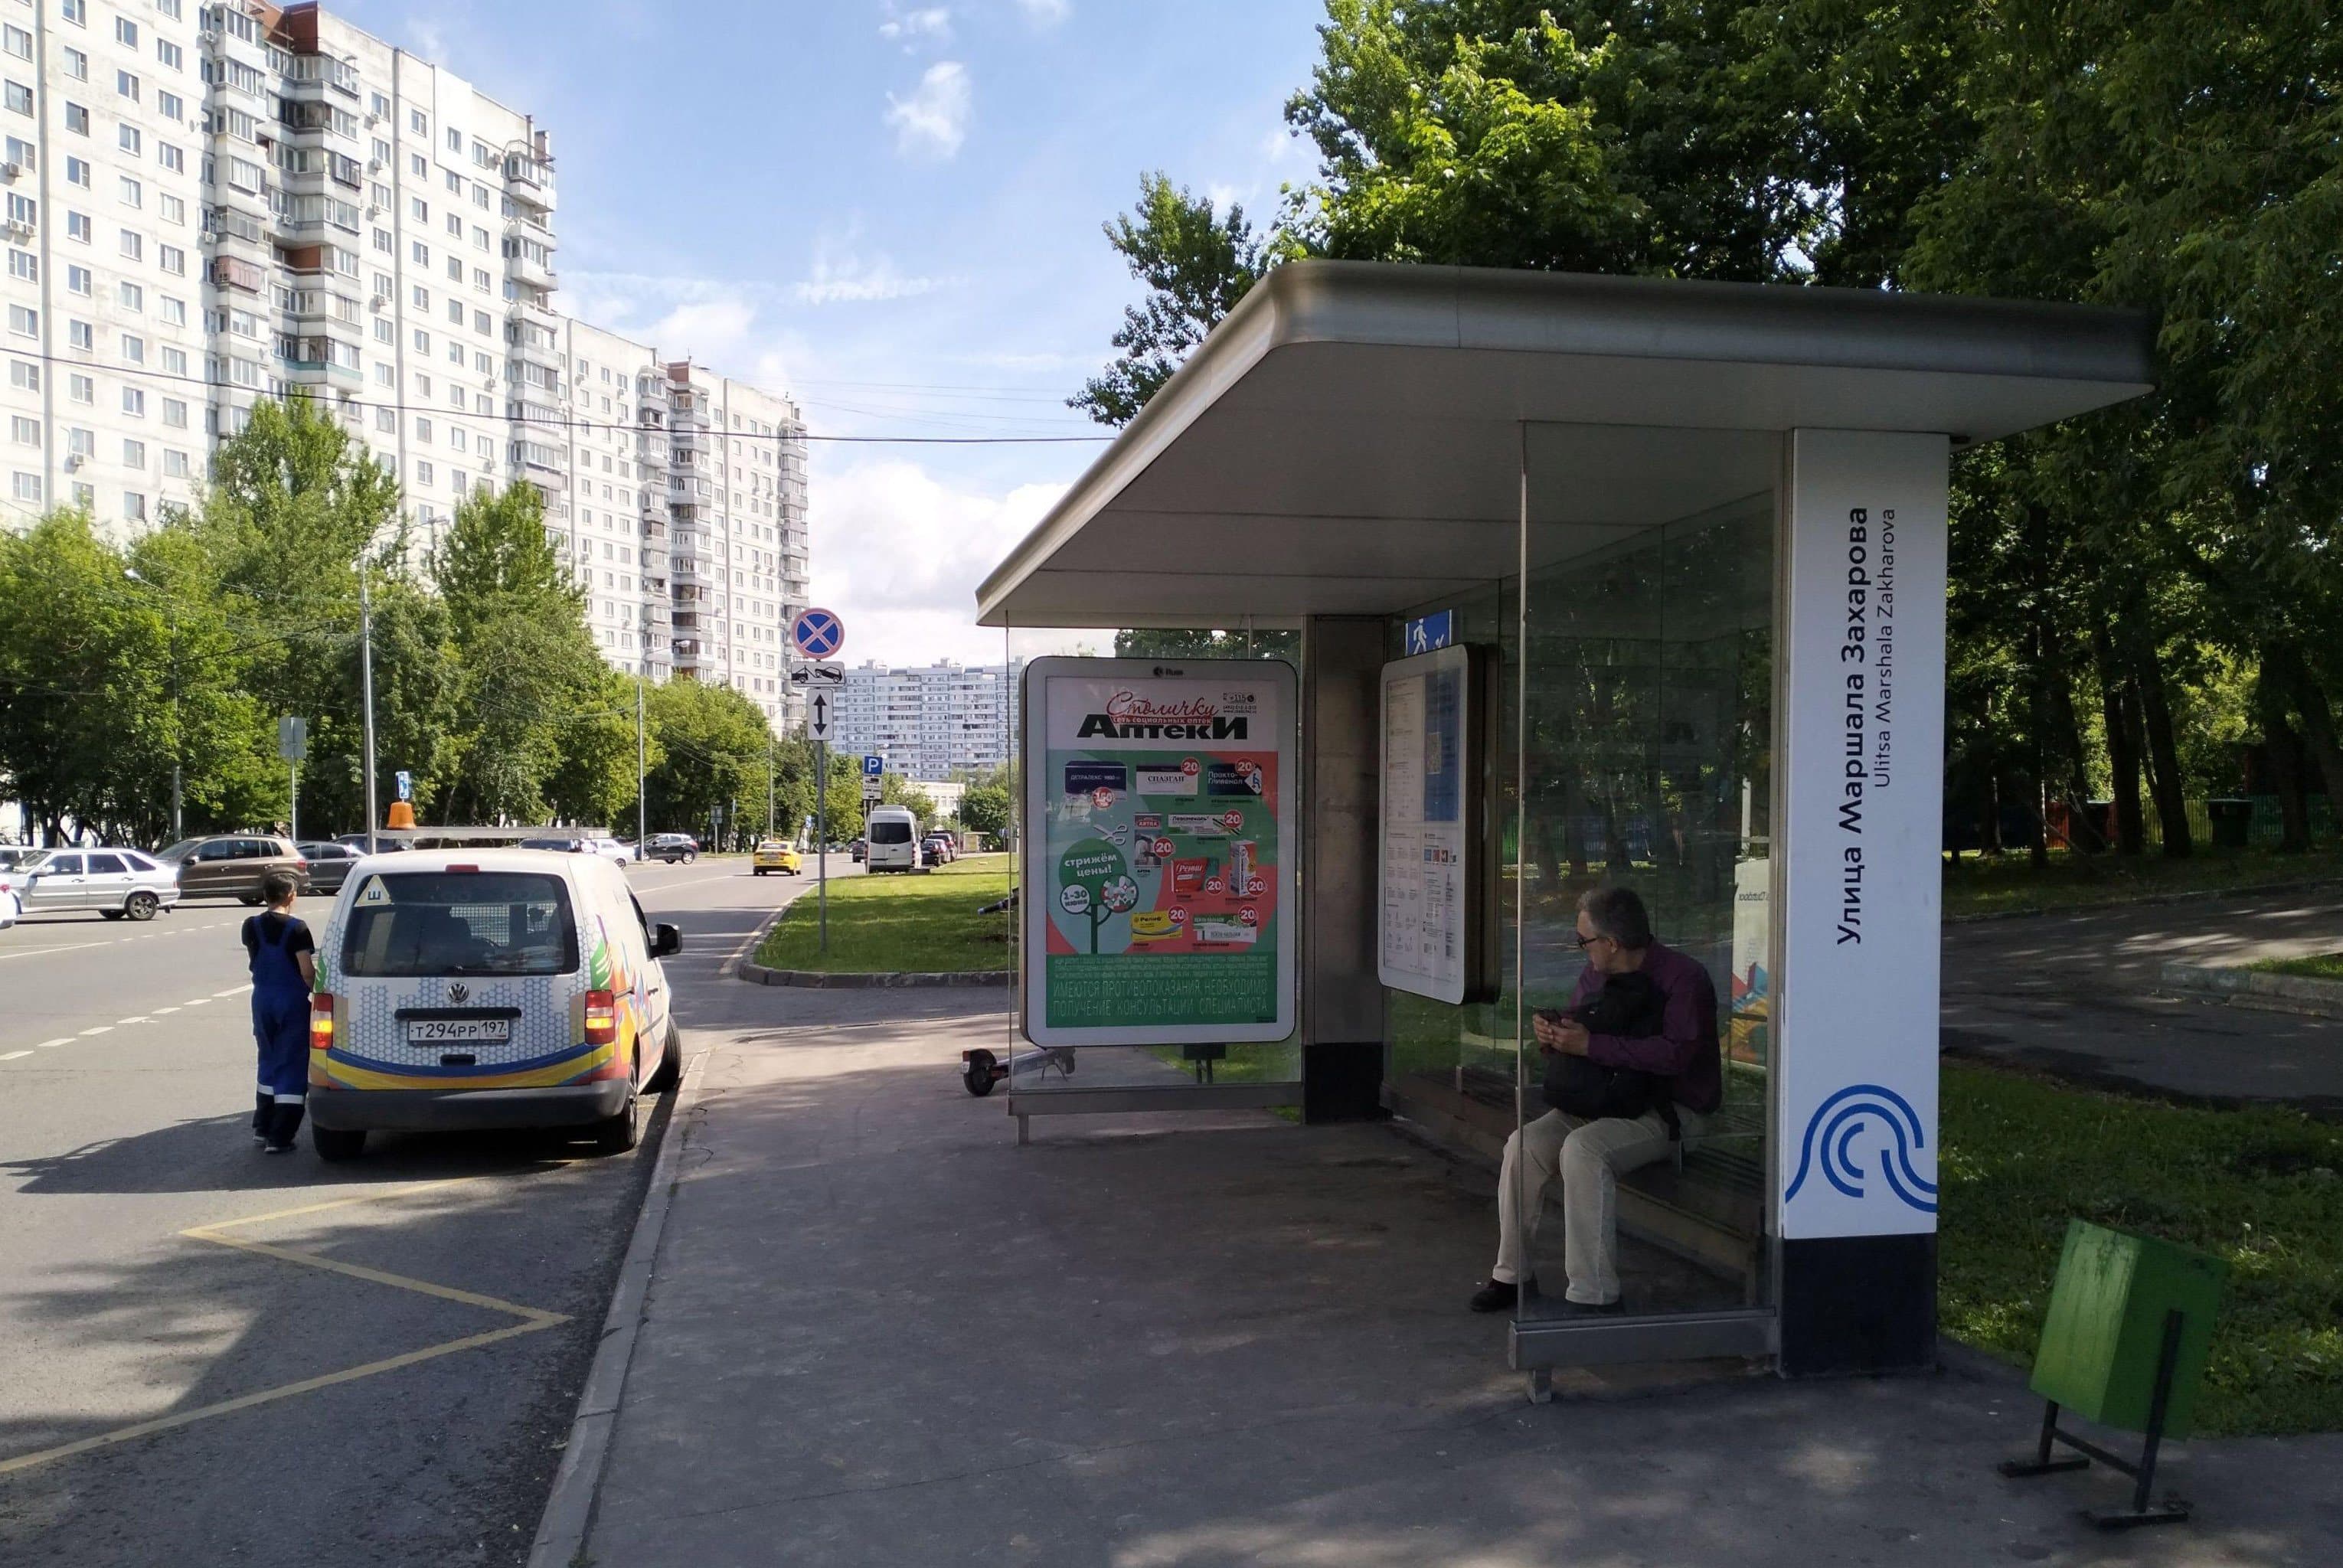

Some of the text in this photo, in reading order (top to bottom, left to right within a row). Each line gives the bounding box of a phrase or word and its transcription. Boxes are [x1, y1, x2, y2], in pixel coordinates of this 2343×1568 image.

[1874, 508, 1895, 788] Ulitsa Marshala Zakharova
[1106, 691, 1219, 717] Столички
[1837, 508, 1871, 946] Улица Маршала Захарова
[1183, 762, 1198, 772] 20
[1237, 762, 1252, 772] 20
[1225, 814, 1240, 824] 20
[1156, 844, 1172, 853] 20
[1064, 852, 1118, 868] стрижём
[1077, 863, 1113, 878] цены!
[1207, 880, 1222, 890] 20
[1248, 880, 1264, 890] 20
[368, 890, 381, 900] Ш
[1064, 890, 1087, 900] 1-30
[1170, 910, 1185, 920] 20
[1240, 910, 1255, 920] 20
[415, 1021, 505, 1038] Т294РР 197
